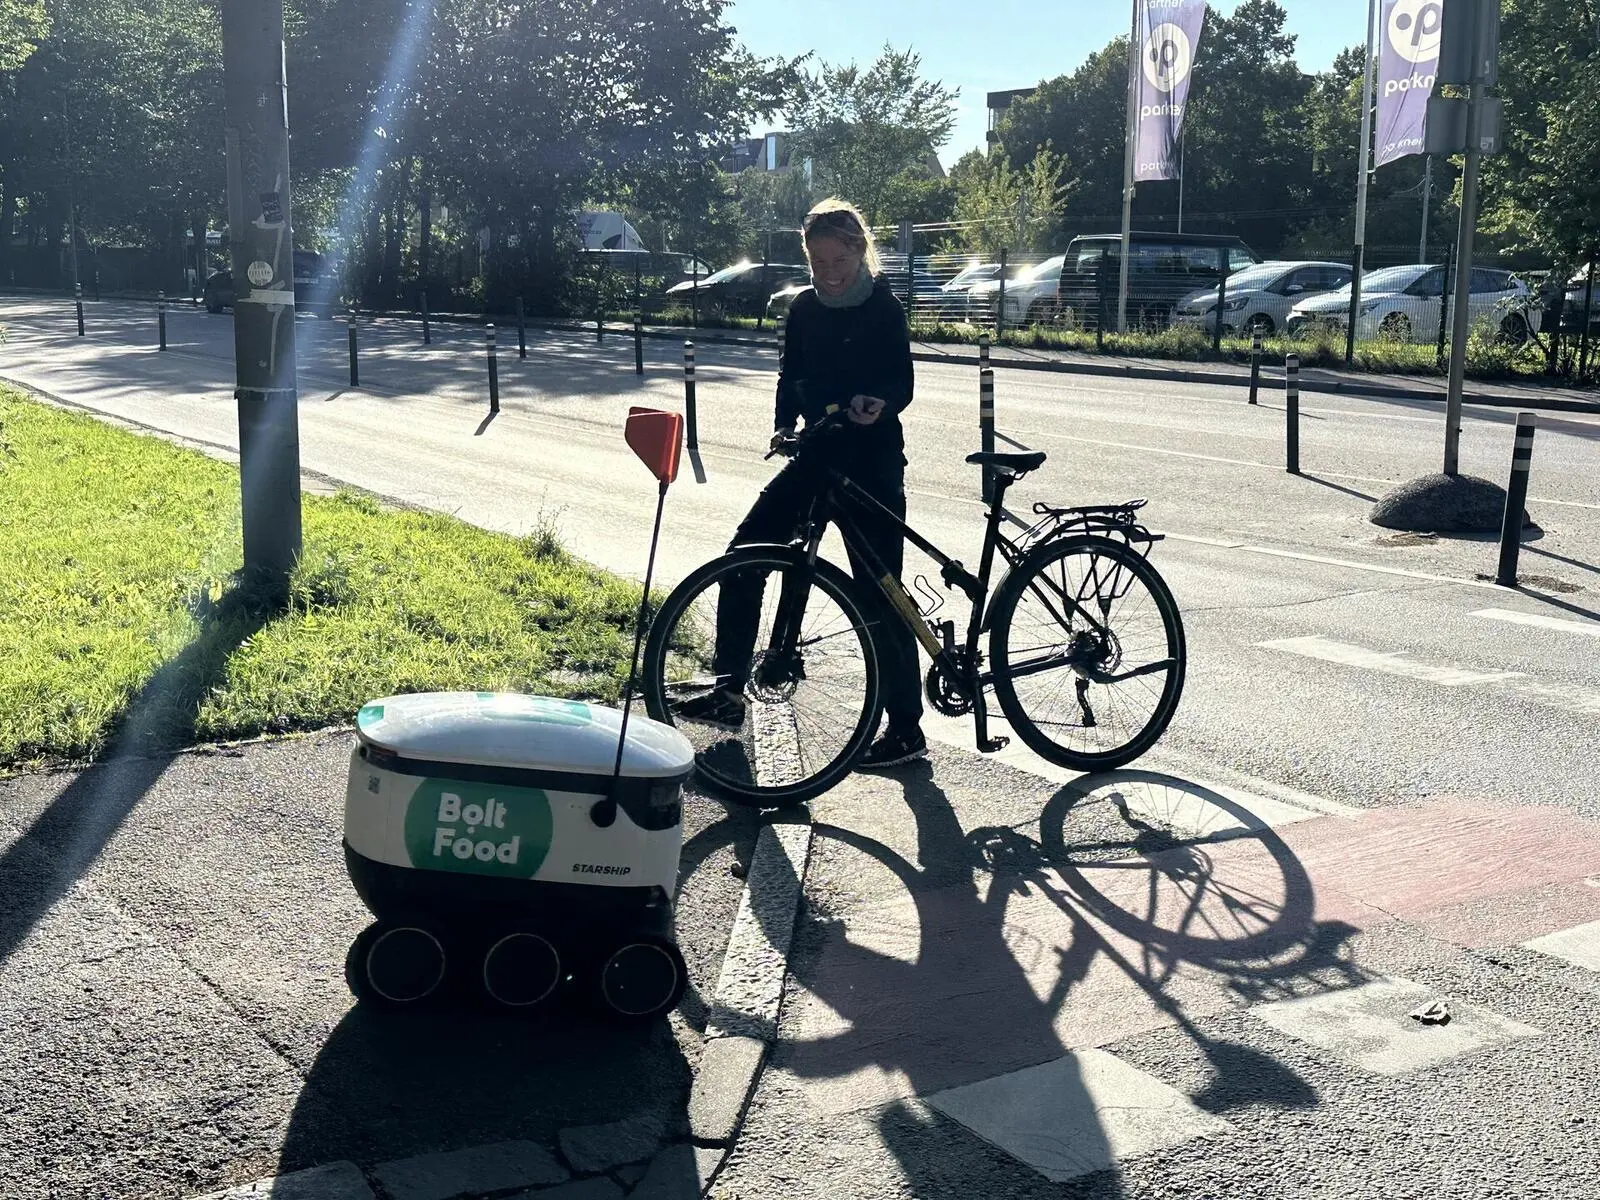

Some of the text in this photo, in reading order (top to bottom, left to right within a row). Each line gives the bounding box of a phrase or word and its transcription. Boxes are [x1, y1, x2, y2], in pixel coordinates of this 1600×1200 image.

[438, 793, 507, 828] Bolt
[433, 828, 519, 865] Food
[571, 862, 631, 877] STARSHIP
